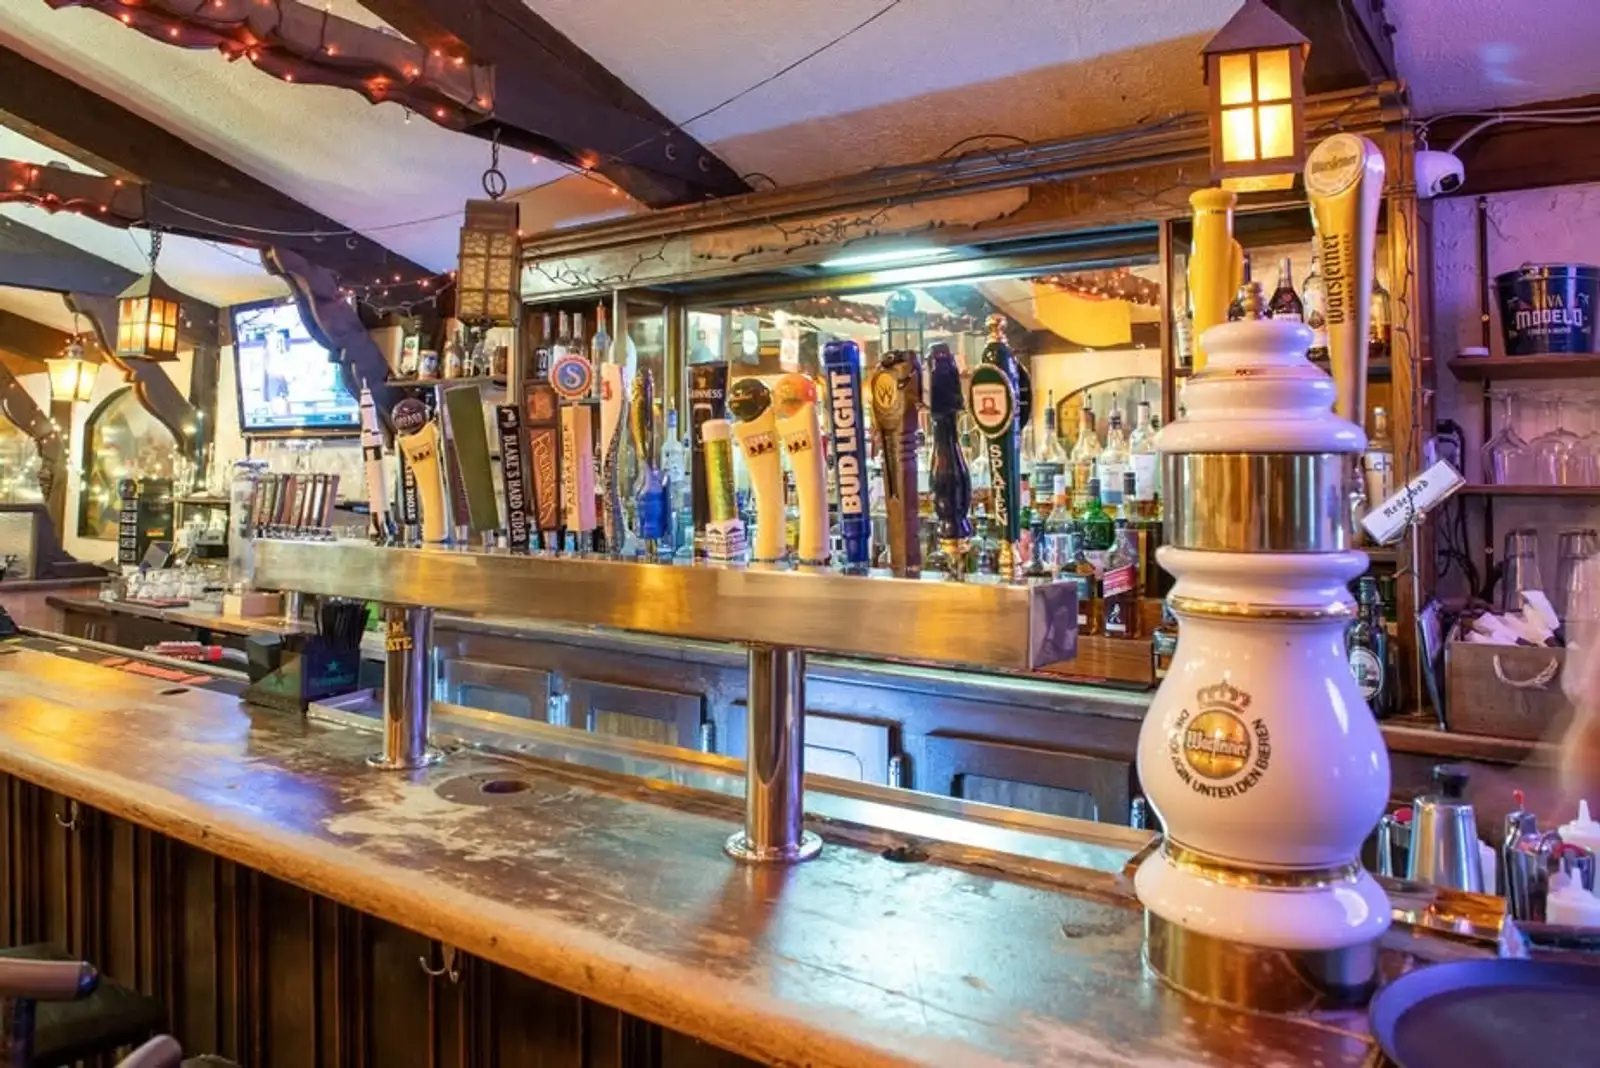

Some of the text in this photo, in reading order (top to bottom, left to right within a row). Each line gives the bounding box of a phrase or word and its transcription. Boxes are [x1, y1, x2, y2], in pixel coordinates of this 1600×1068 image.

[1515, 308, 1583, 330] MODELO
[830, 371, 863, 514] BUD LIGHT
[508, 479, 524, 510] HARD
[989, 443, 1009, 527] SPATEN
[511, 510, 527, 542] CIDER
[1191, 779, 1238, 799] UNTER
[1235, 767, 1263, 794] DEN
[1251, 718, 1272, 771] BIEREN
